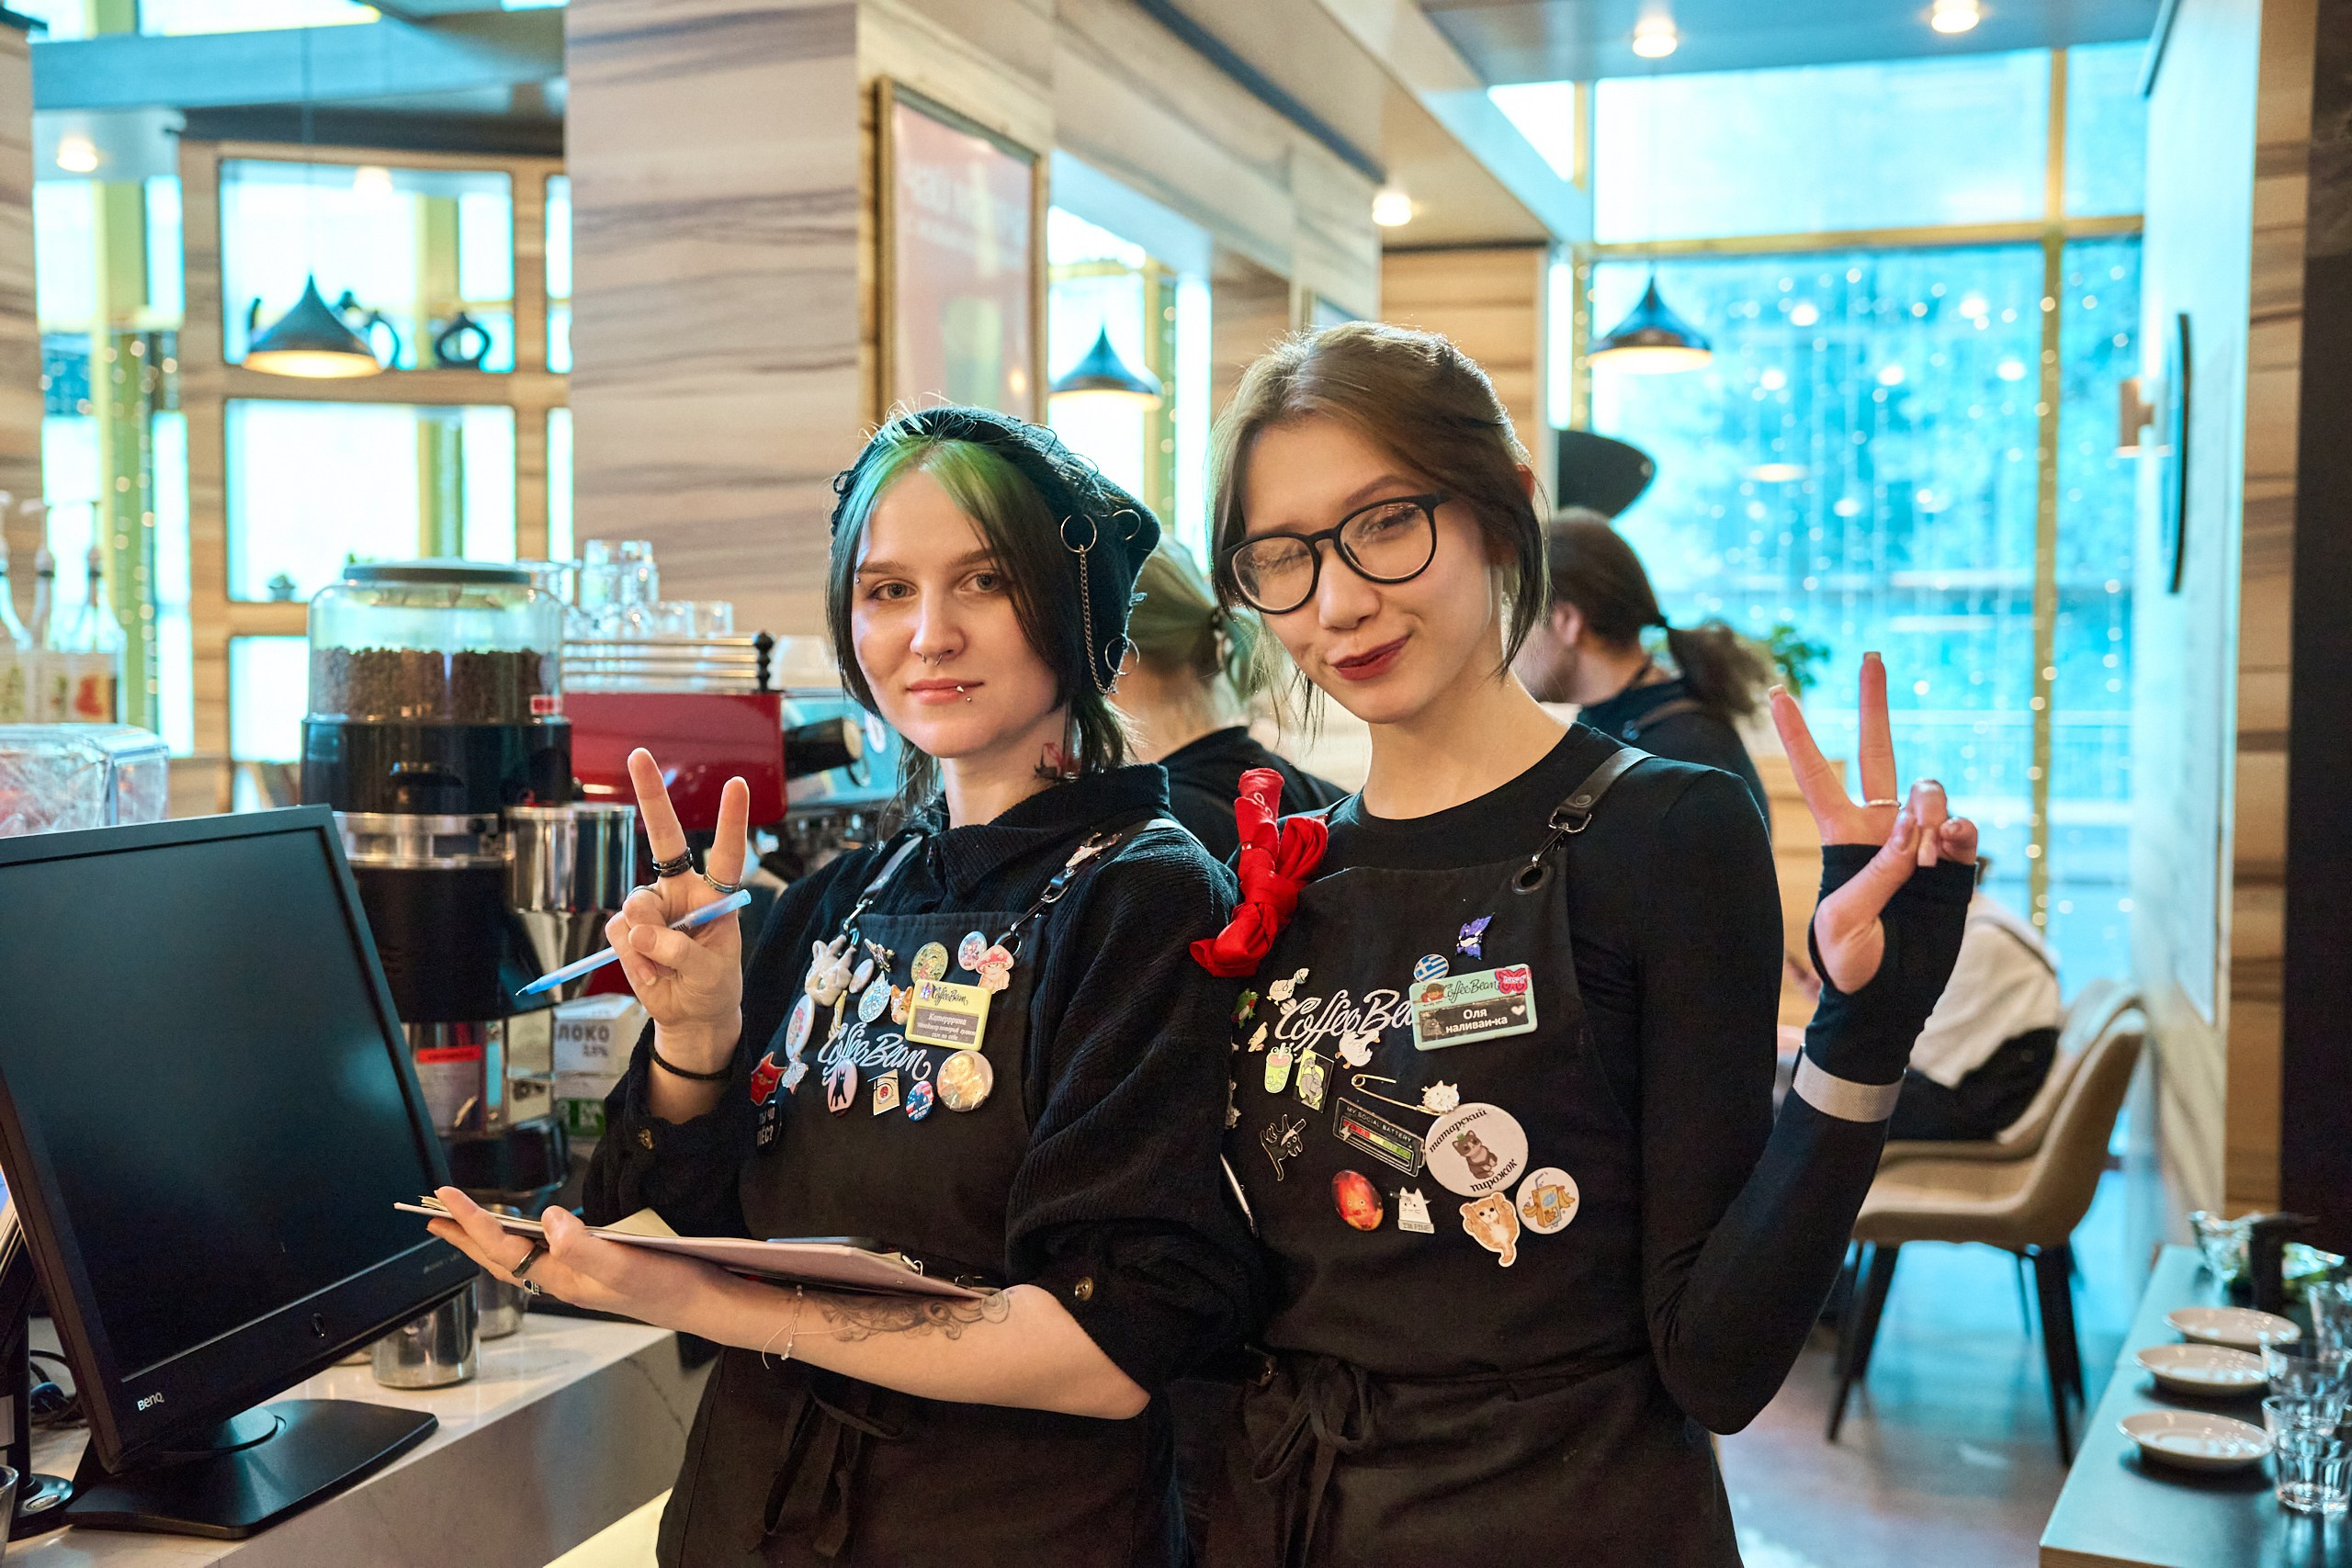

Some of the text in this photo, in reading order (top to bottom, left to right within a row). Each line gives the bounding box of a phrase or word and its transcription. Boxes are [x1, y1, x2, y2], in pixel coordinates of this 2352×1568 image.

[1274, 989, 1413, 1064] Coffee Bea
[1463, 1009, 1487, 1020] Оля
[558, 1023, 609, 1042] ЛОКО
[817, 1021, 932, 1086] Coffee Bean
[1346, 1106, 1357, 1114] MY
[1358, 1111, 1380, 1127] SOCIAL
[1382, 1123, 1412, 1142] BATTERY
[1429, 1108, 1487, 1153] татарский
[1470, 1158, 1518, 1192] пирожок
[137, 1393, 164, 1411] BenQ
